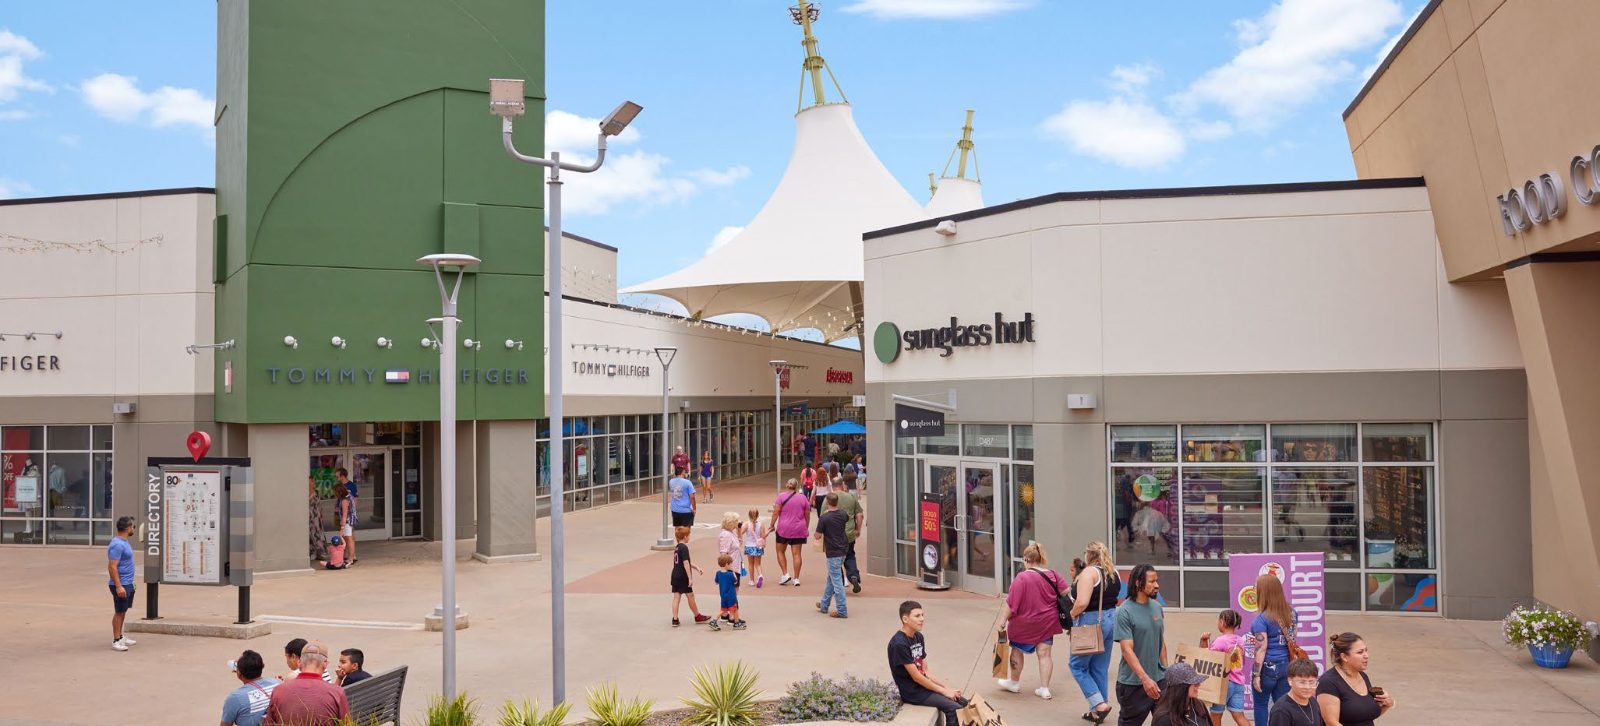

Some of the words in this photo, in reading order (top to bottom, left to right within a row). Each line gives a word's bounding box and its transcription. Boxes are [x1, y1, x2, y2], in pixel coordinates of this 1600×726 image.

[1497, 171, 1568, 237] FOOD
[903, 316, 993, 357] sunglass
[995, 312, 1035, 344] hut
[268, 368, 377, 384] TOMMY
[573, 360, 607, 376] TOMMY
[617, 363, 650, 378] HILFIGER
[148, 473, 161, 556] DIRECTORY
[1290, 555, 1323, 638] COURT
[1193, 658, 1223, 678] NIKE
